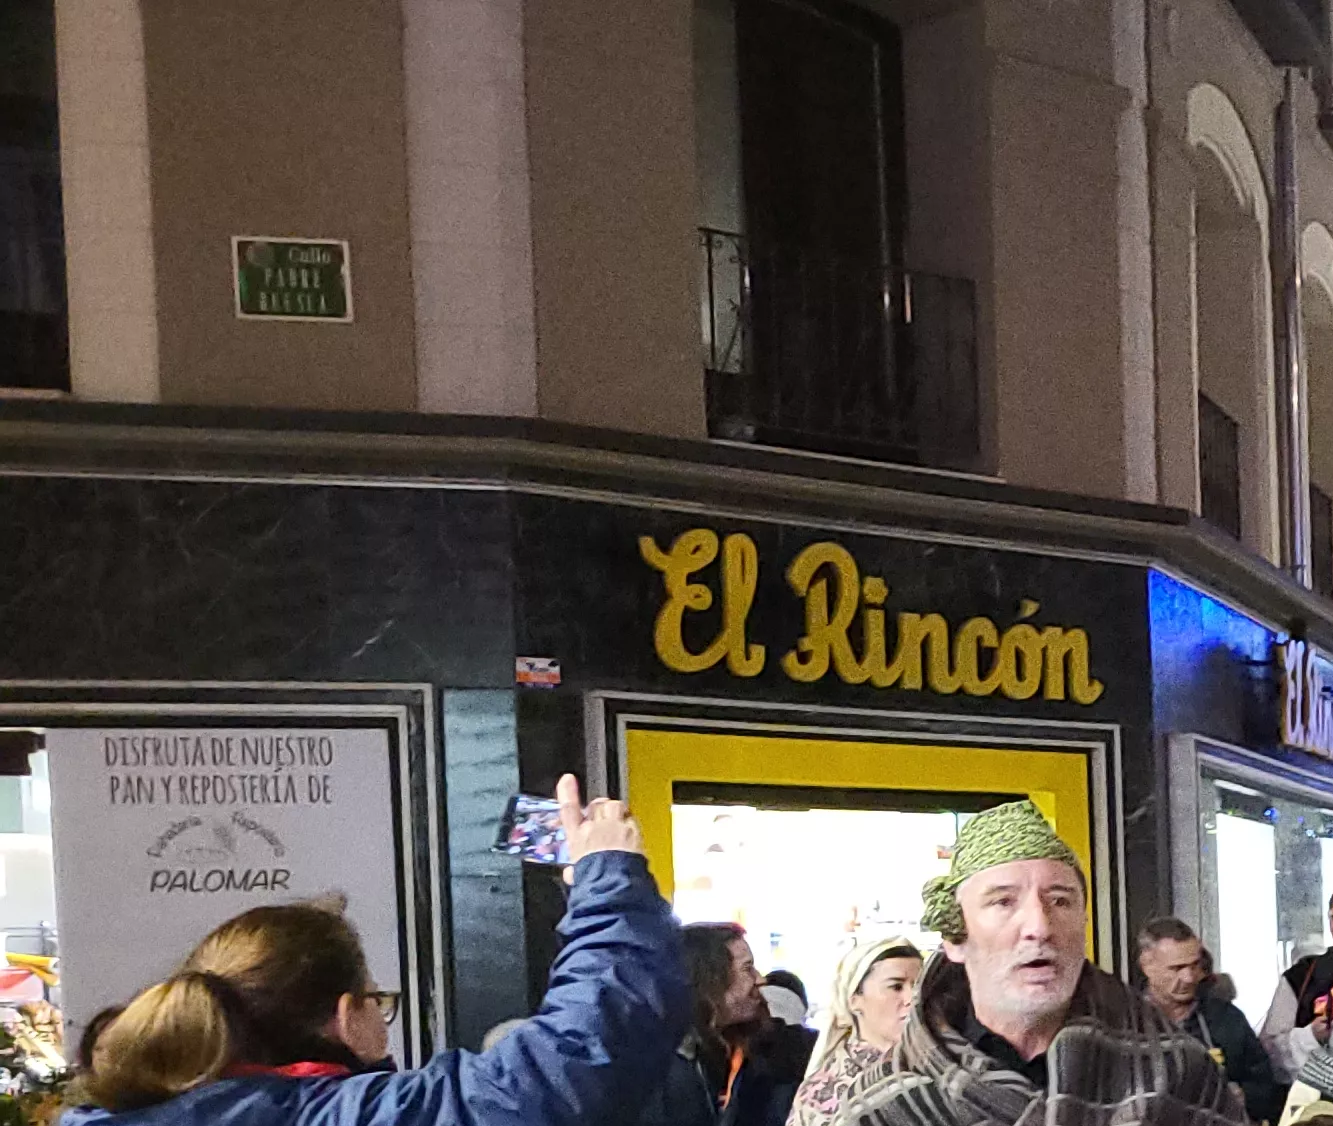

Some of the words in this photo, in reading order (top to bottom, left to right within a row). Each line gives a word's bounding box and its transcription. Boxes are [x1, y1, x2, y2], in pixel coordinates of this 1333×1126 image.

[638, 528, 766, 678] El
[781, 541, 1104, 705] Rincón
[105, 736, 206, 767] DISFRUTA
[211, 736, 238, 766] DE
[240, 736, 334, 767] NUESTRO
[110, 775, 154, 804] PAN
[160, 775, 173, 804] Y
[178, 767, 299, 805] REPOSTERÍA
[308, 774, 333, 804] DE
[150, 868, 291, 893] PALOMAR
